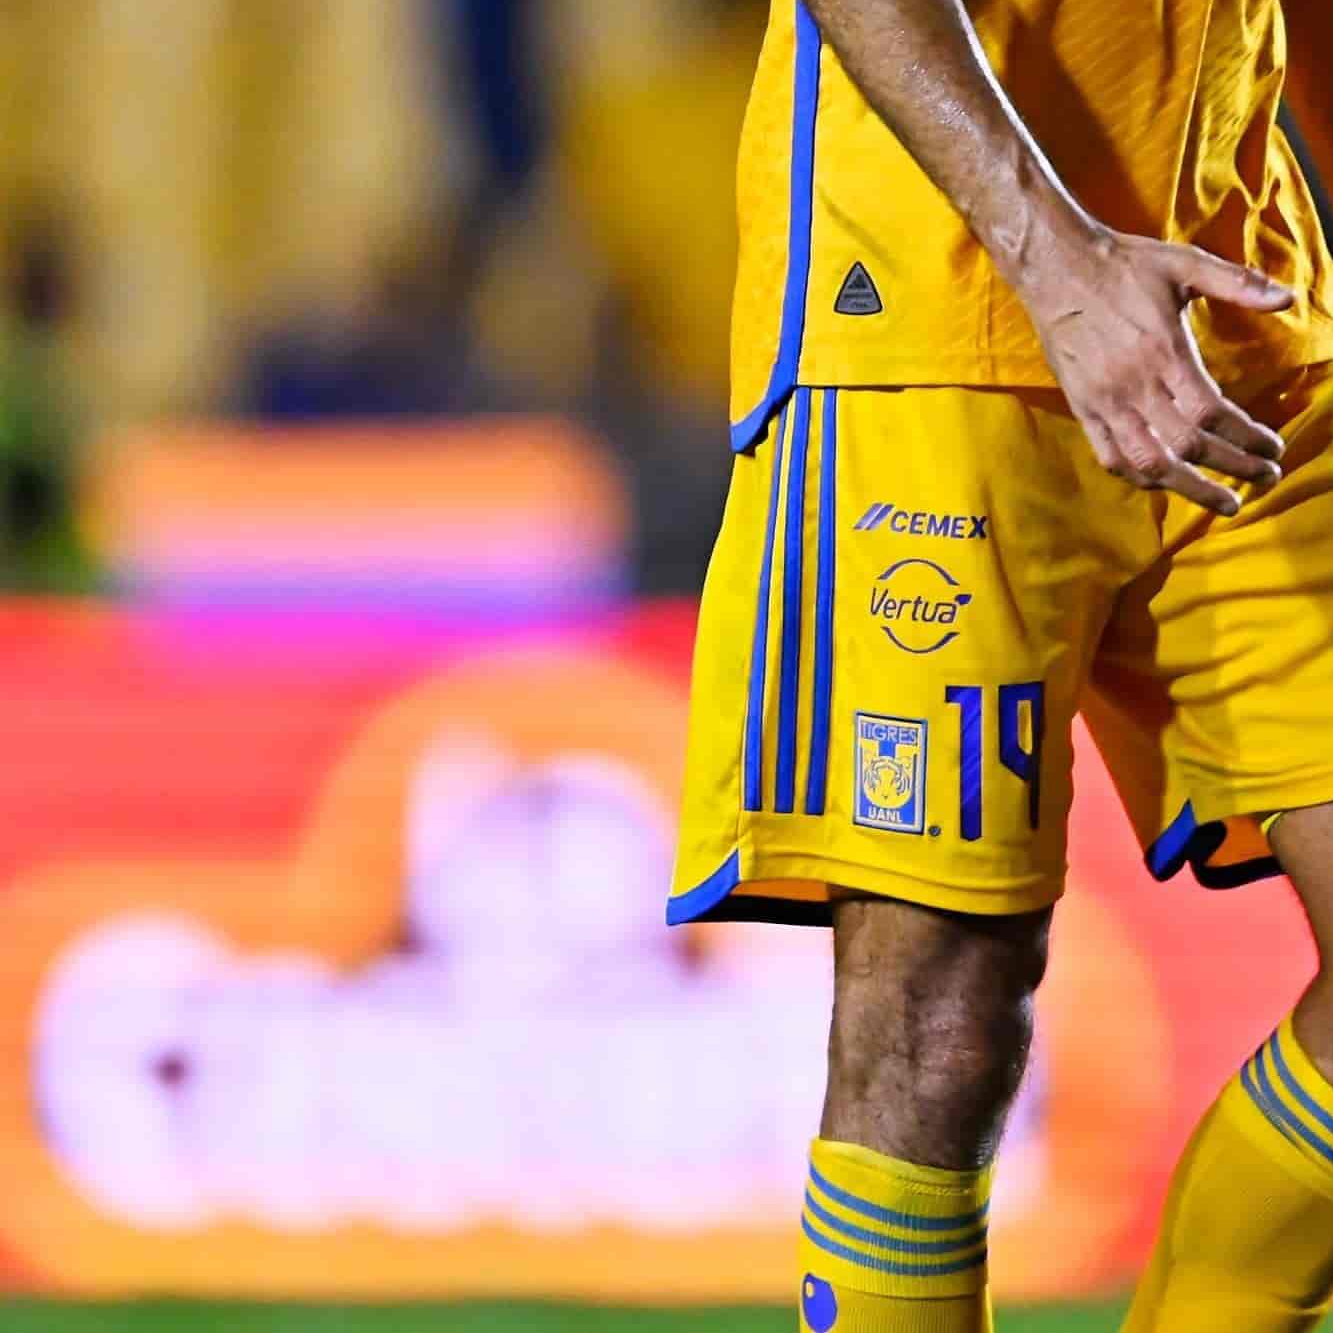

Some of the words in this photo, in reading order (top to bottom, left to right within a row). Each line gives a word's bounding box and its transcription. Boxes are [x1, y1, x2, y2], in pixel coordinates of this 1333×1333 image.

[889, 511, 988, 539] CEMEX
[869, 585, 960, 625] Vertua
[944, 680, 1046, 842] 19
[867, 805, 903, 824] UANL
